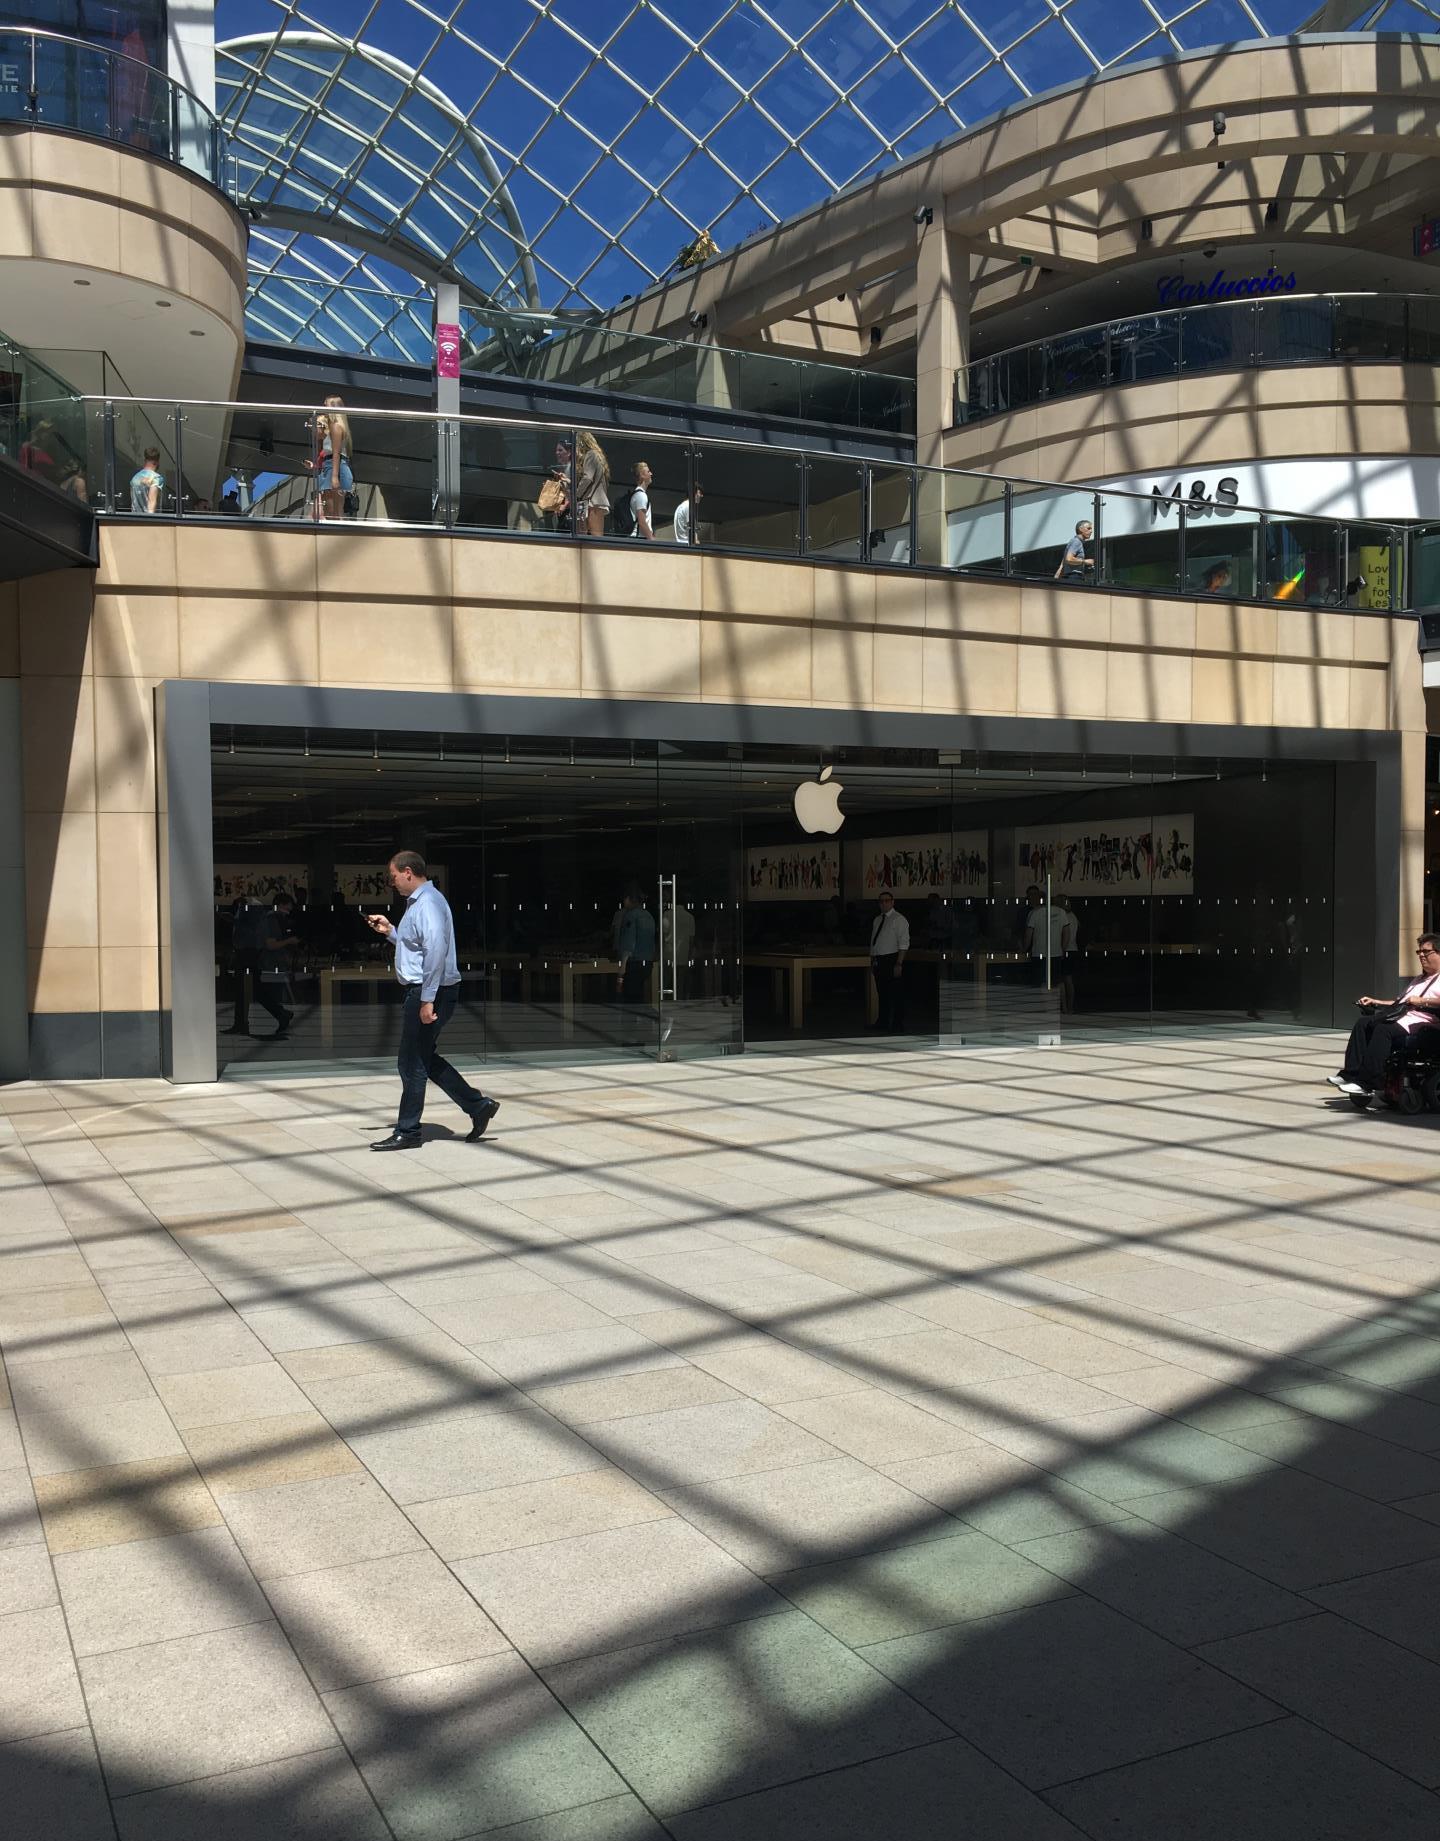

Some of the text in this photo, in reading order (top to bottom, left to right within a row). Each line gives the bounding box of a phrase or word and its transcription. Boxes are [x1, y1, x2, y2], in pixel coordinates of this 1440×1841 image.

[0, 64, 19, 82] E
[1152, 477, 1239, 519] M&S
[1368, 563, 1389, 574] Lov
[1377, 576, 1385, 586] it
[1368, 598, 1389, 608] Les
